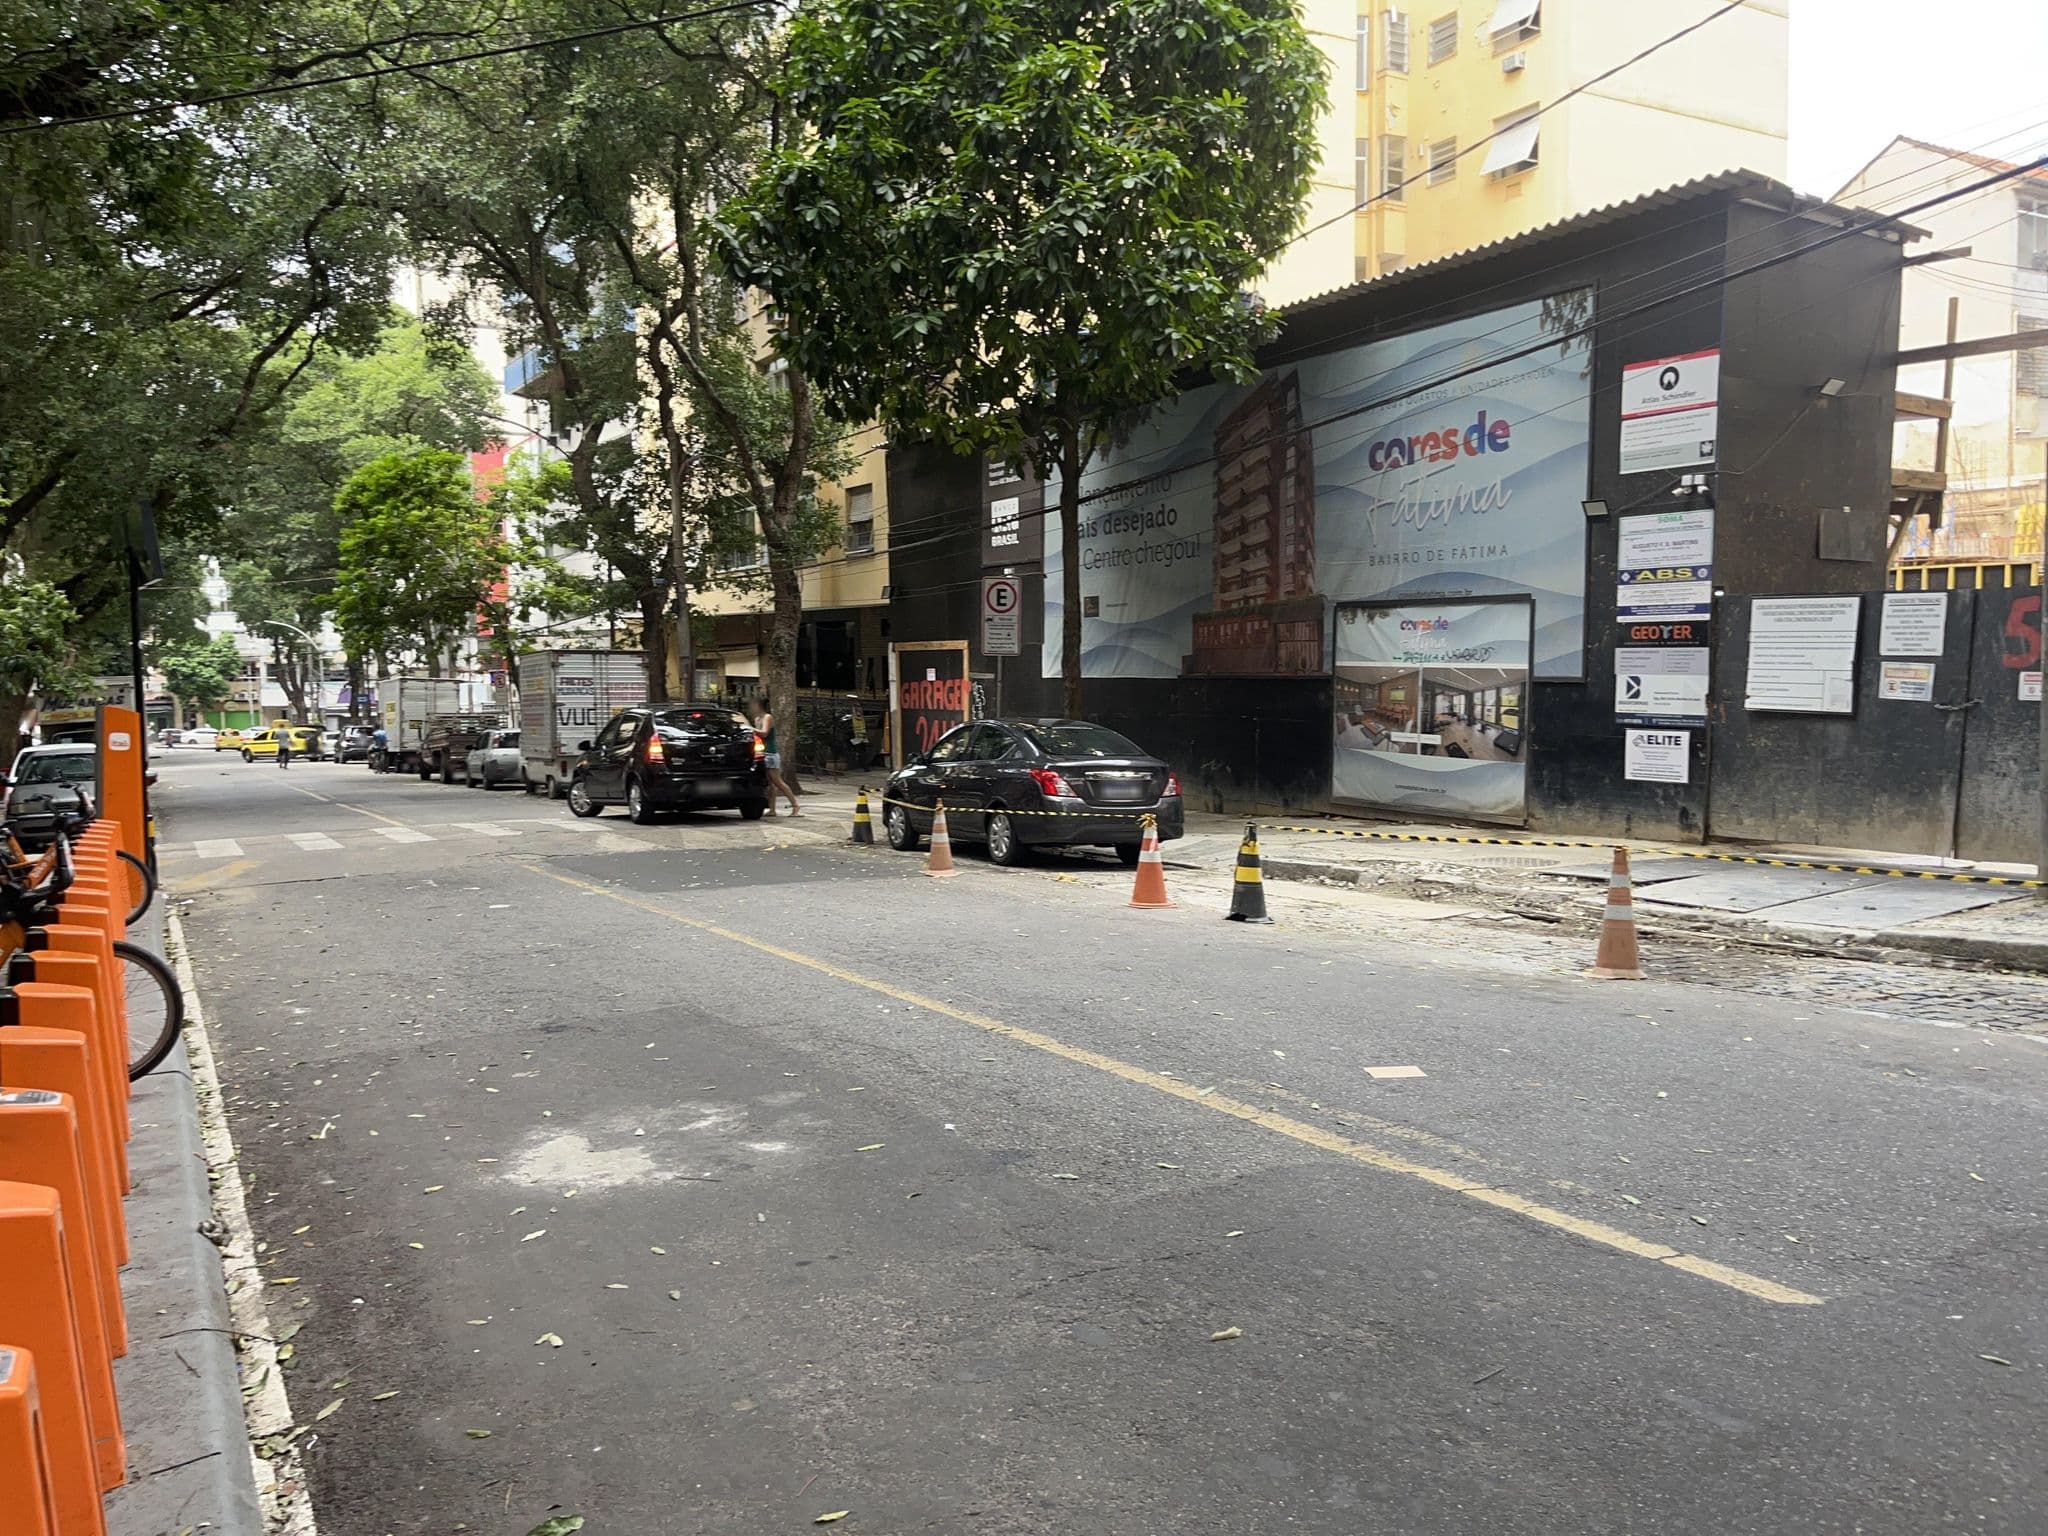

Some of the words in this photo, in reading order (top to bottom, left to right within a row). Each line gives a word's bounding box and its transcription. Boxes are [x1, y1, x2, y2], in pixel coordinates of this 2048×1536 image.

[1078, 515, 1098, 539] ais
[1103, 503, 1178, 536] desejado
[1083, 547, 1131, 570] Centro
[1134, 533, 1201, 568] chegou!
[1368, 551, 1421, 567] BAIRRO
[1427, 549, 1445, 562] DE
[1635, 568, 1694, 581] ABS
[996, 588, 1008, 607] E
[2003, 595, 2042, 669] 5
[1646, 734, 1682, 747] ELITE
